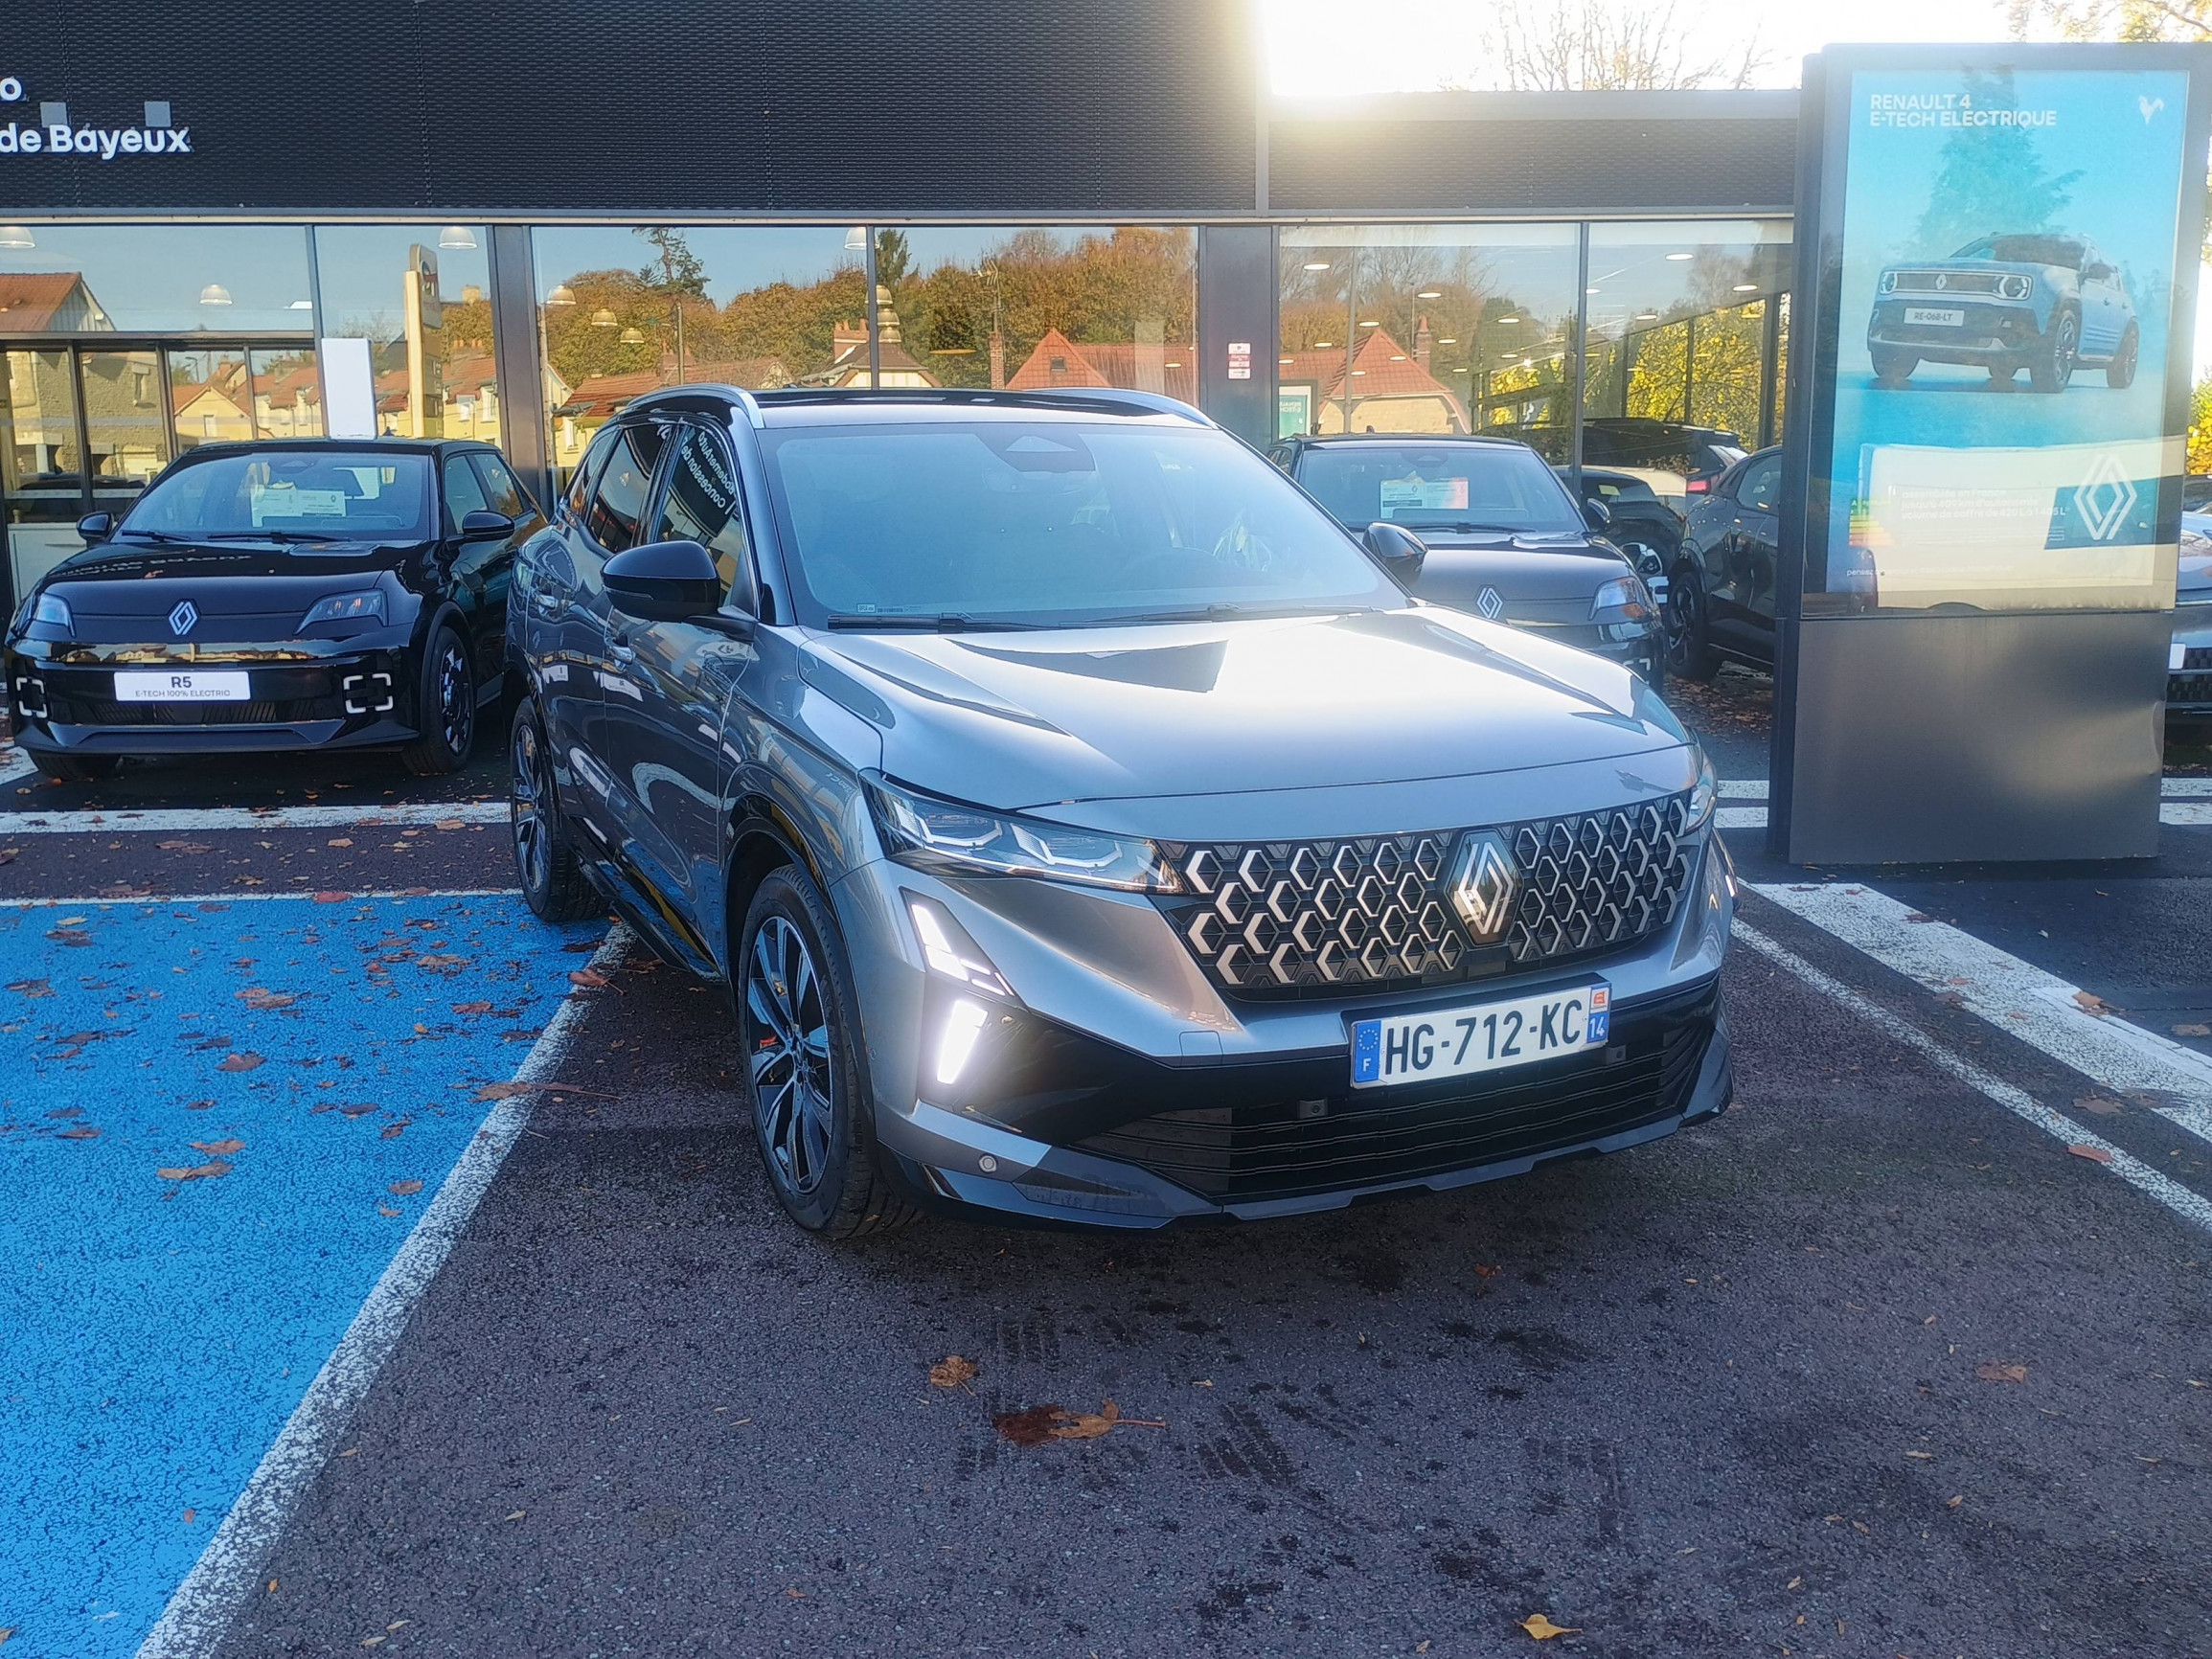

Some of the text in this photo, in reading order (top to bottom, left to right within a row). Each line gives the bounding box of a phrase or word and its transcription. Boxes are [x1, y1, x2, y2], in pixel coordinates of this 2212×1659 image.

[1871, 94, 1972, 110] RENAULT 4
[1869, 110, 2057, 128] E-TECH ELECTRIQUE
[0, 123, 191, 160] de Bayeux
[171, 676, 192, 689] R5
[1362, 999, 1606, 1076] F HG-712-KC 14
